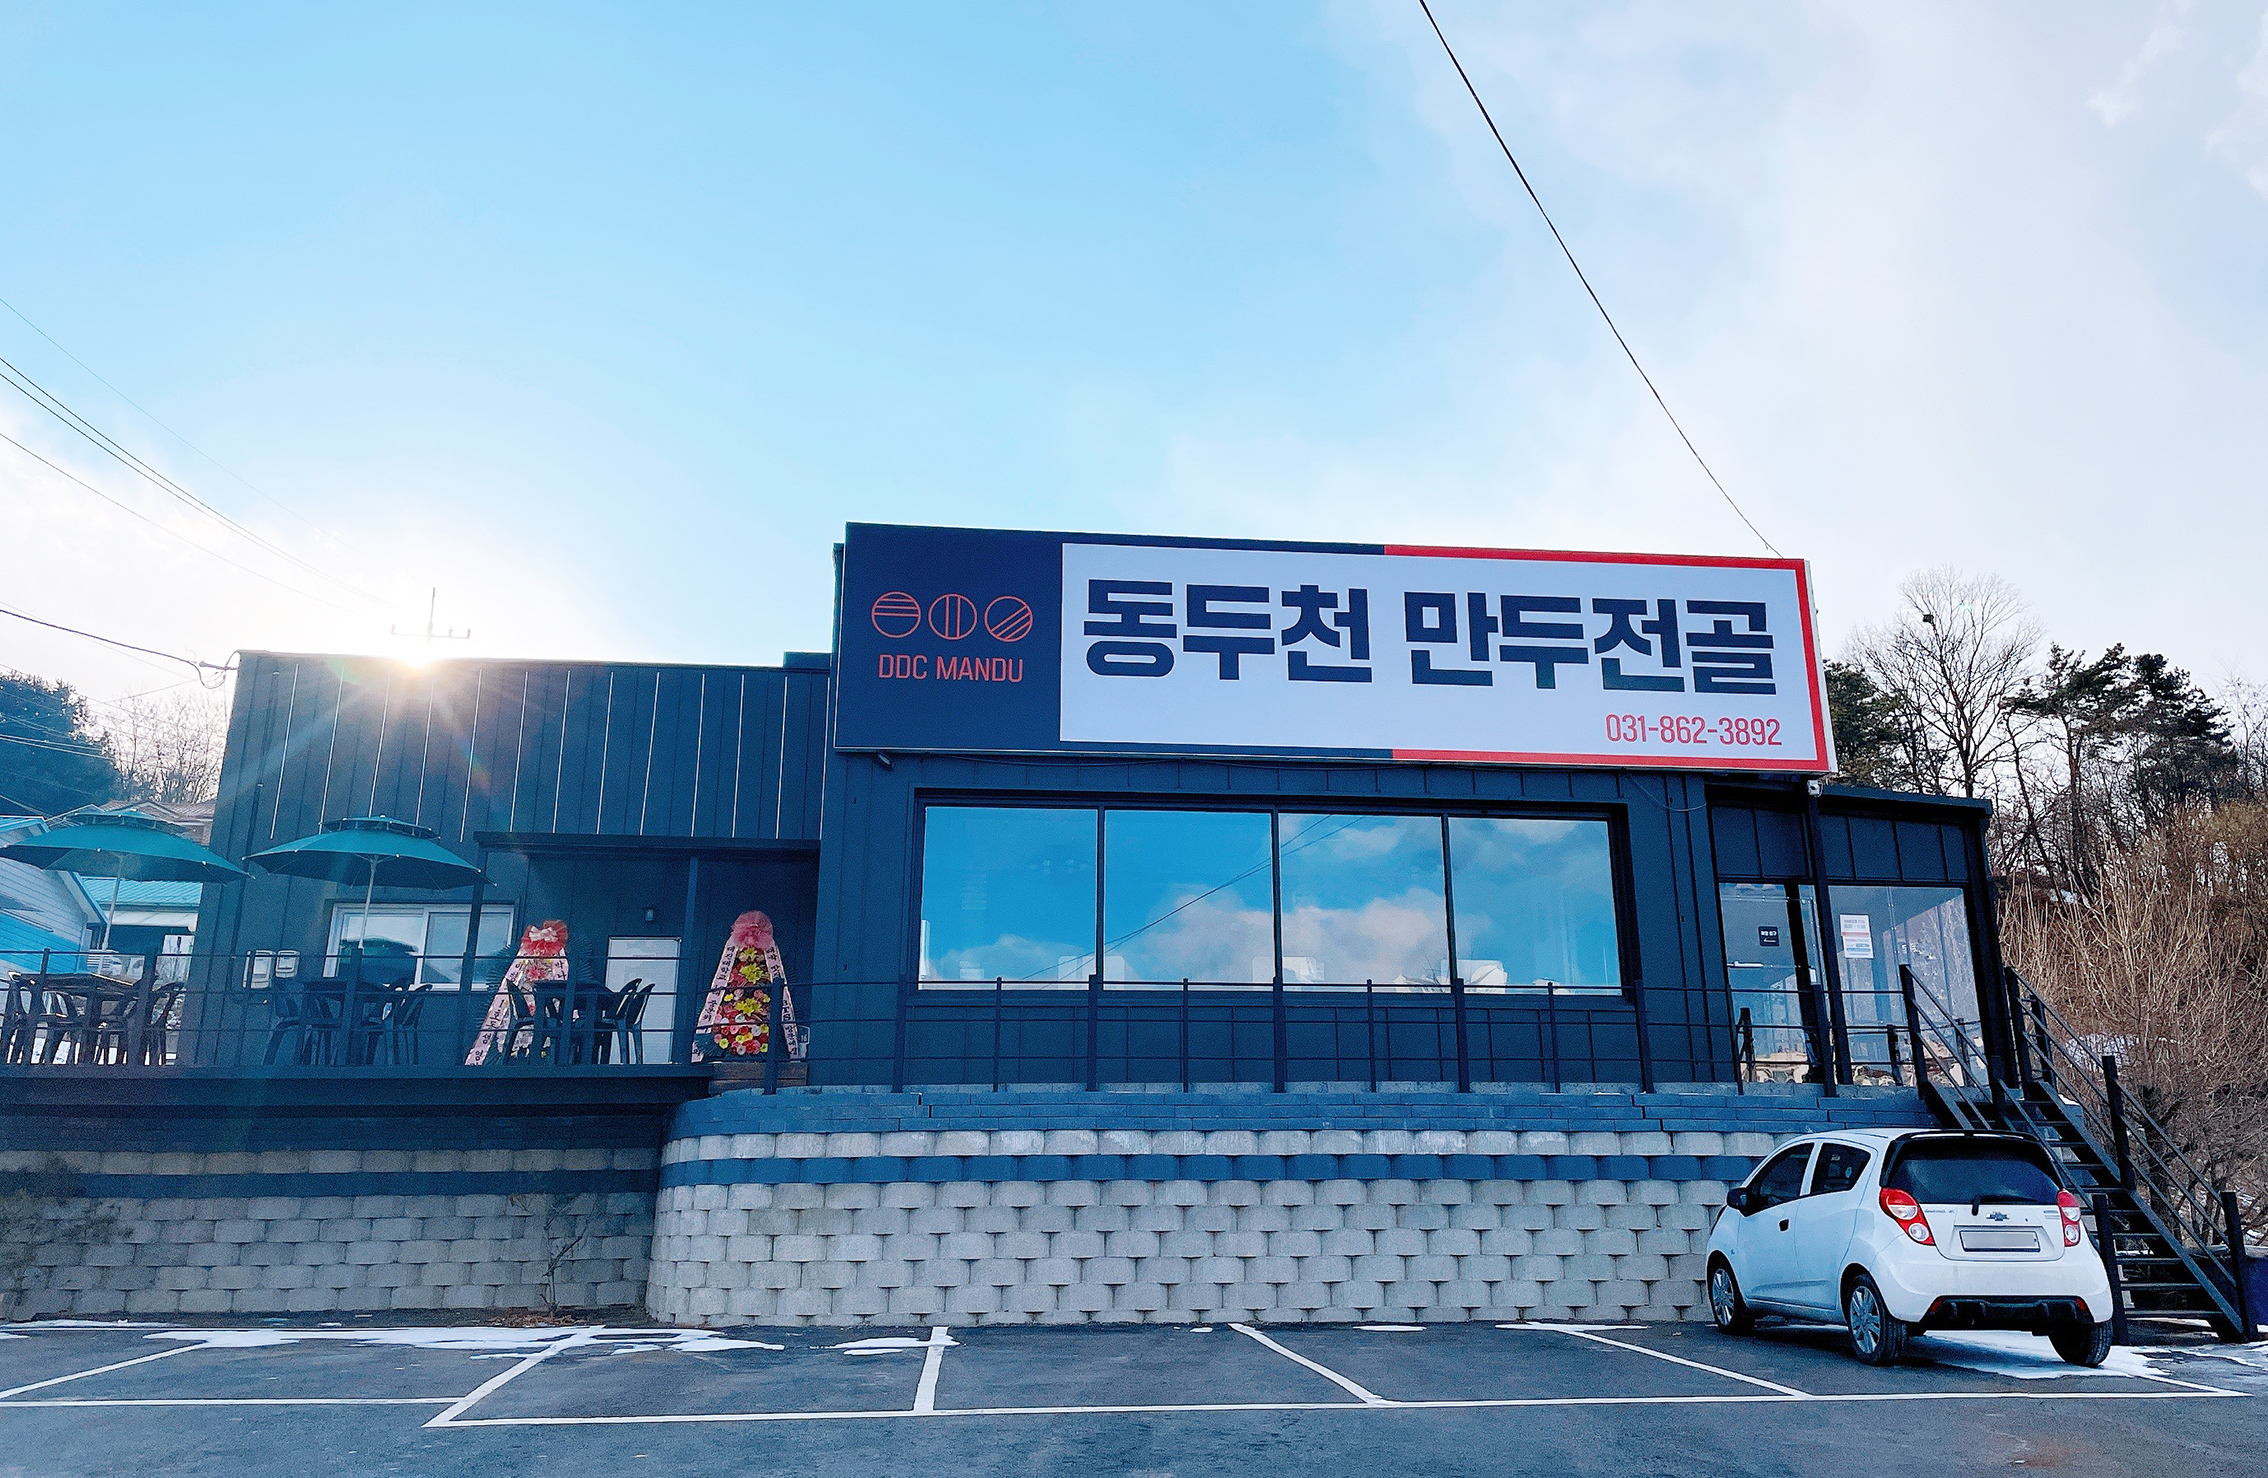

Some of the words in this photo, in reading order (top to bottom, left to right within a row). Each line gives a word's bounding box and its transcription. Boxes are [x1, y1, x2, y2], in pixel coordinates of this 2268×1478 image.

[1083, 578, 1373, 683] 동두천
[1404, 591, 1777, 695] 만두전골
[878, 654, 928, 680] DDC
[935, 656, 1024, 683] MANDU
[1605, 713, 1783, 747] 031-862-3892
